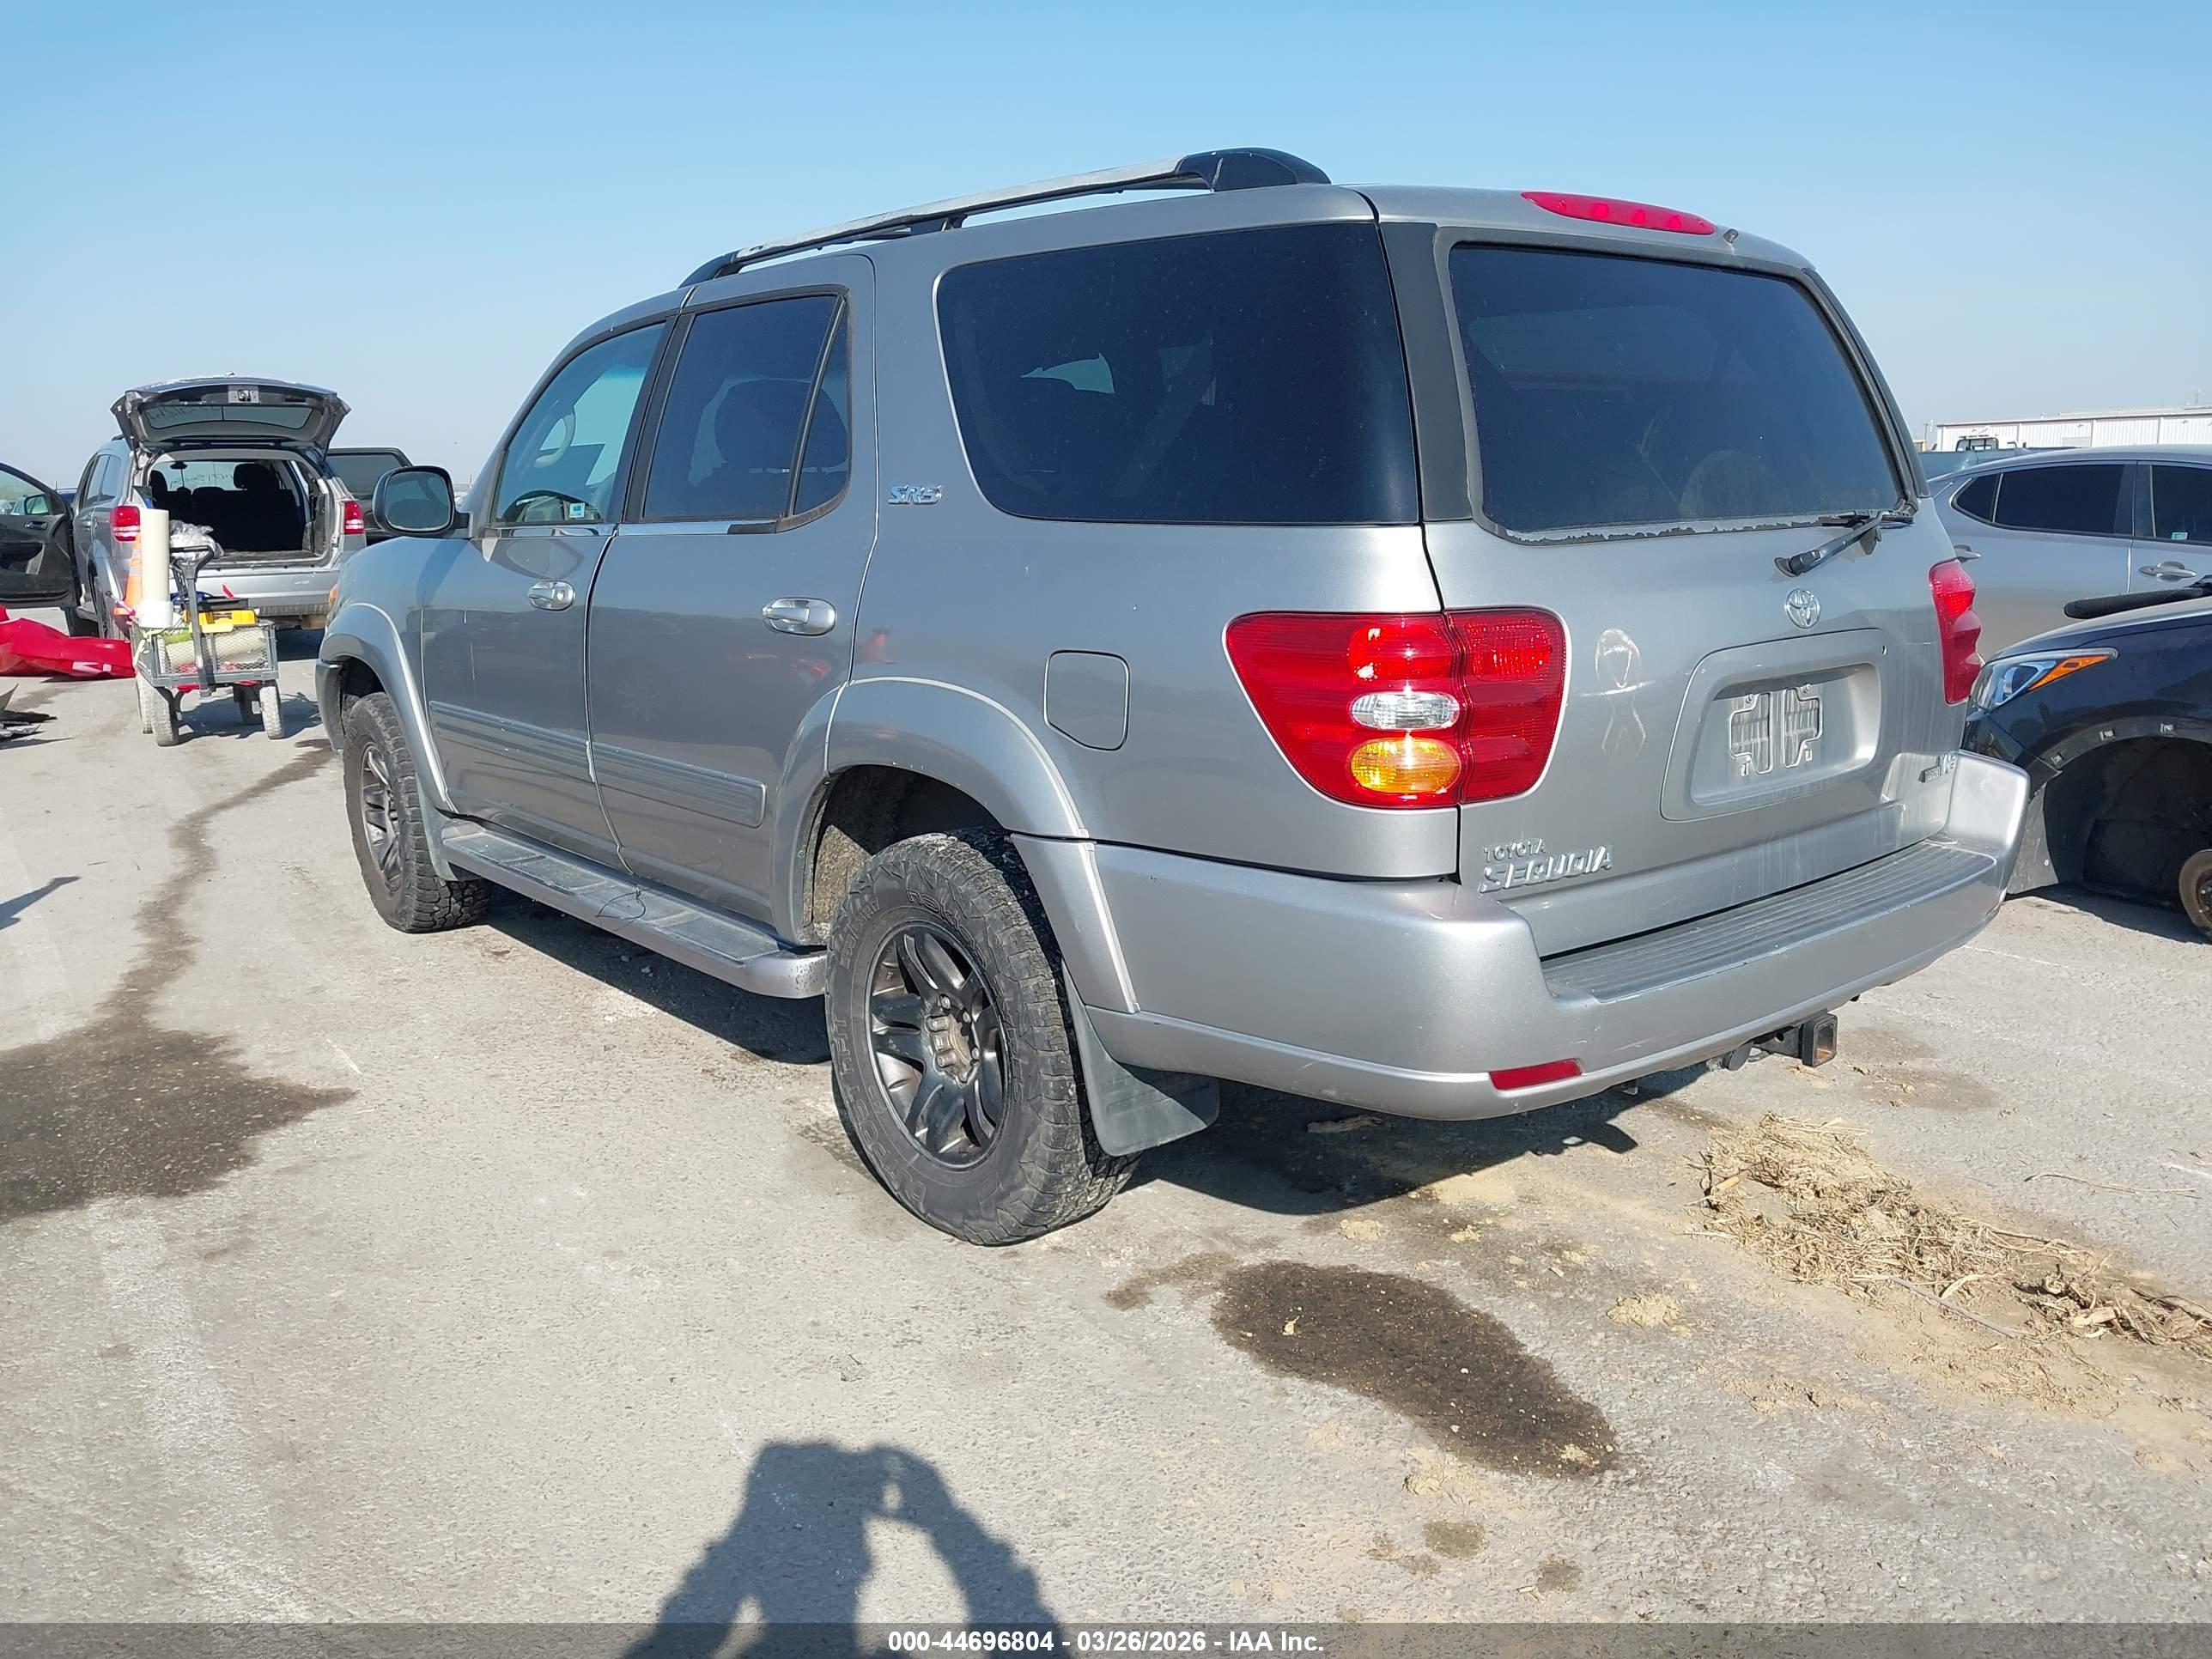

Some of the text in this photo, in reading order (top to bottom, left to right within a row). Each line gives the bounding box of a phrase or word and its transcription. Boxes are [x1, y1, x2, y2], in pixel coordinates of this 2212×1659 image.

[887, 483, 943, 505] SR5
[1483, 837, 1547, 862] TOYOTA
[1477, 845, 1614, 893] SEQUOIA
